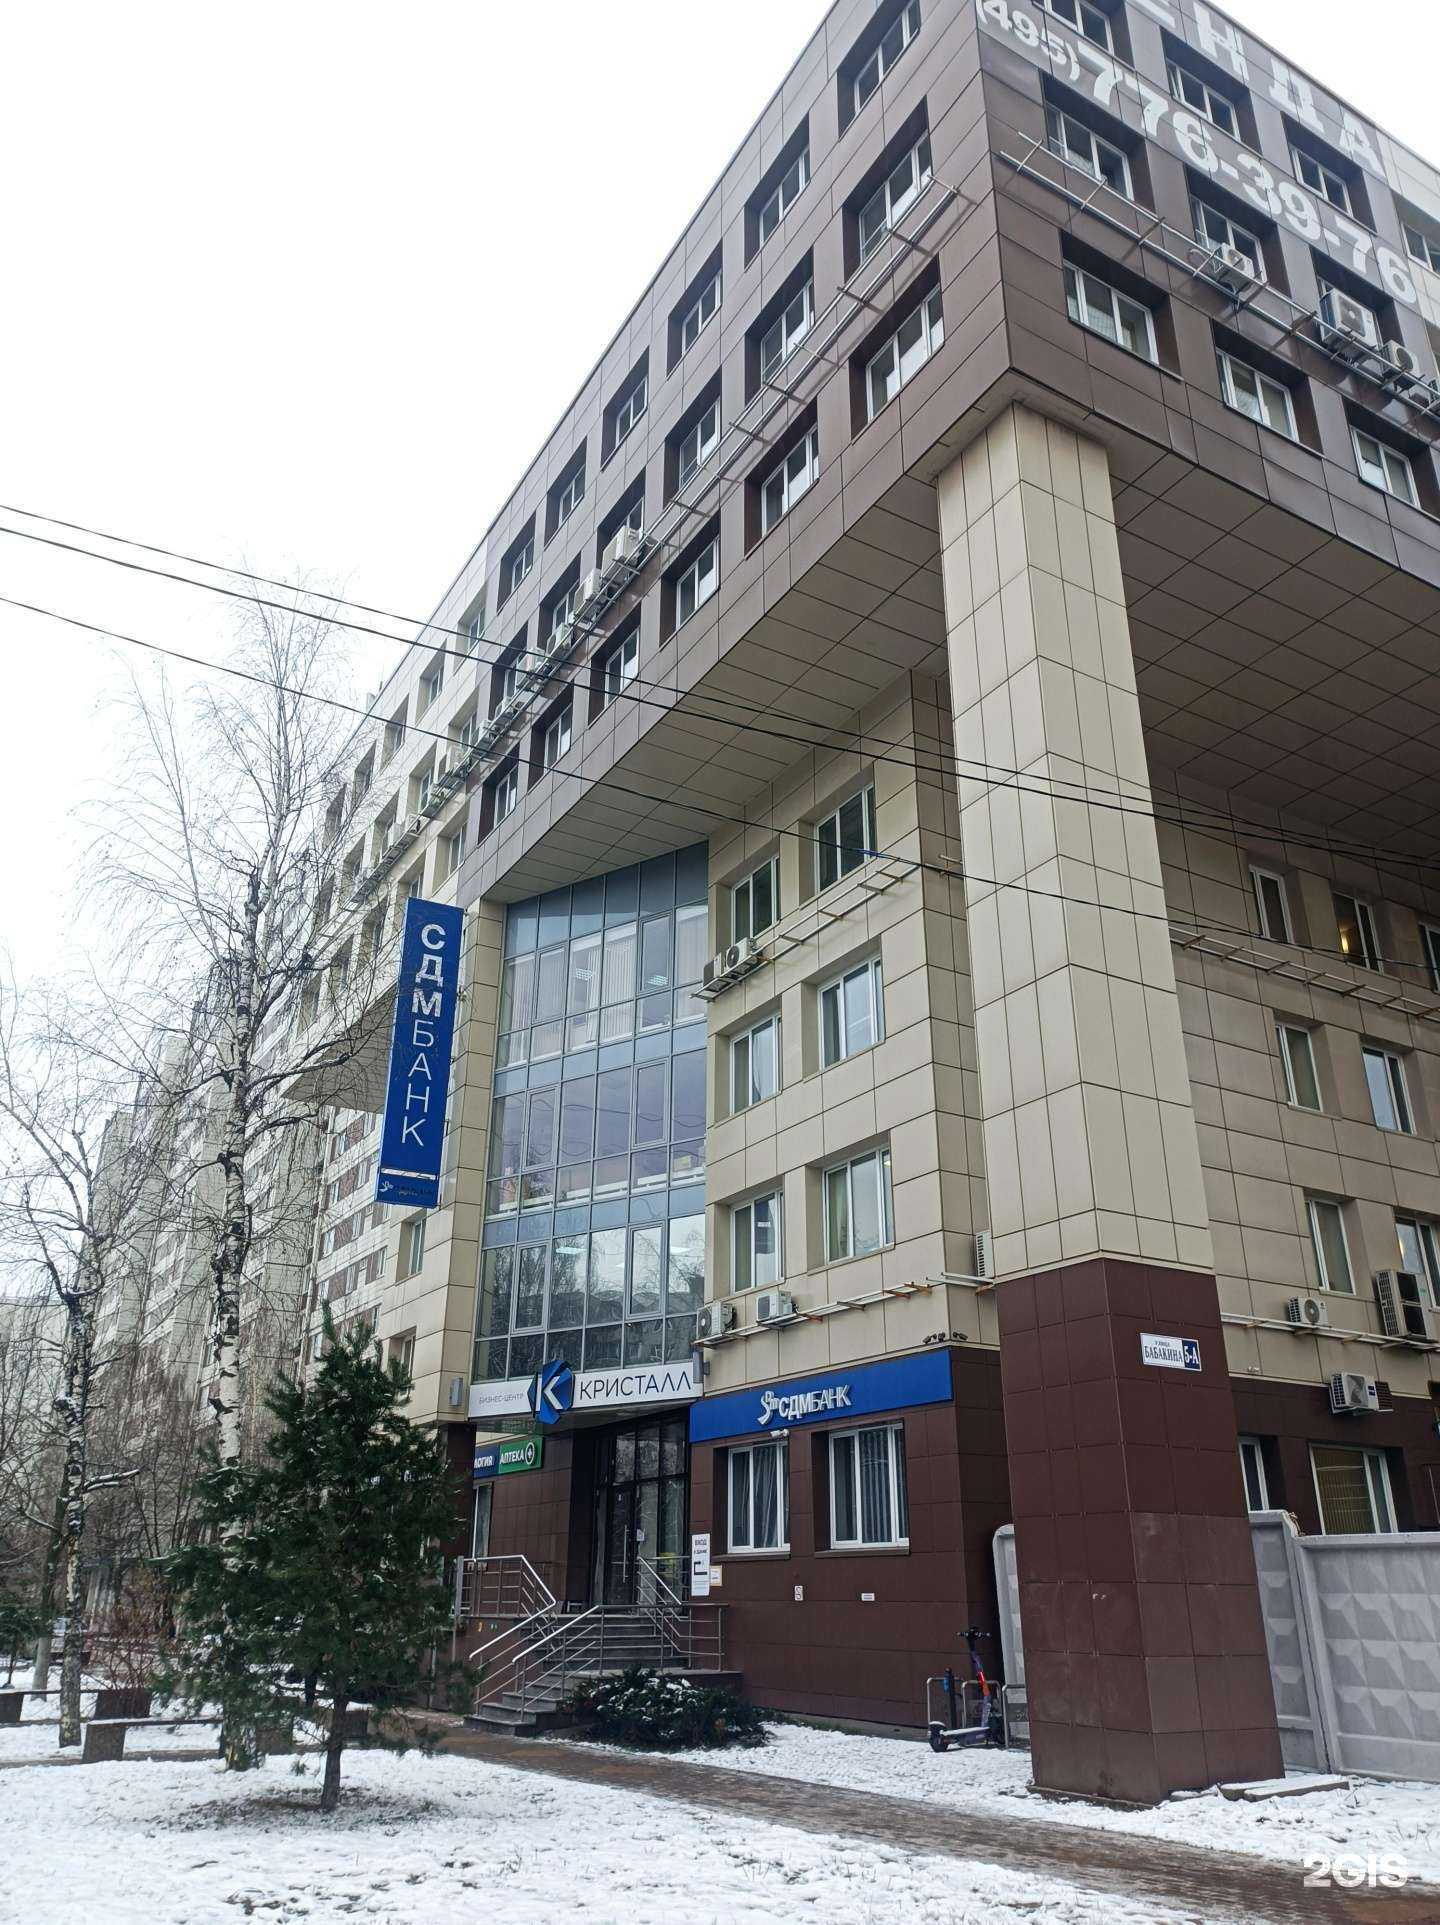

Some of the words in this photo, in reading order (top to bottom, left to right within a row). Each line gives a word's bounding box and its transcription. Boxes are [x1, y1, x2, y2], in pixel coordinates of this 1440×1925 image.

[1144, 1346, 1183, 1363] БАБАКИНА
[579, 1371, 691, 1400] КРИСТАЛЛ
[499, 1449, 524, 1465] АПТЕКА
